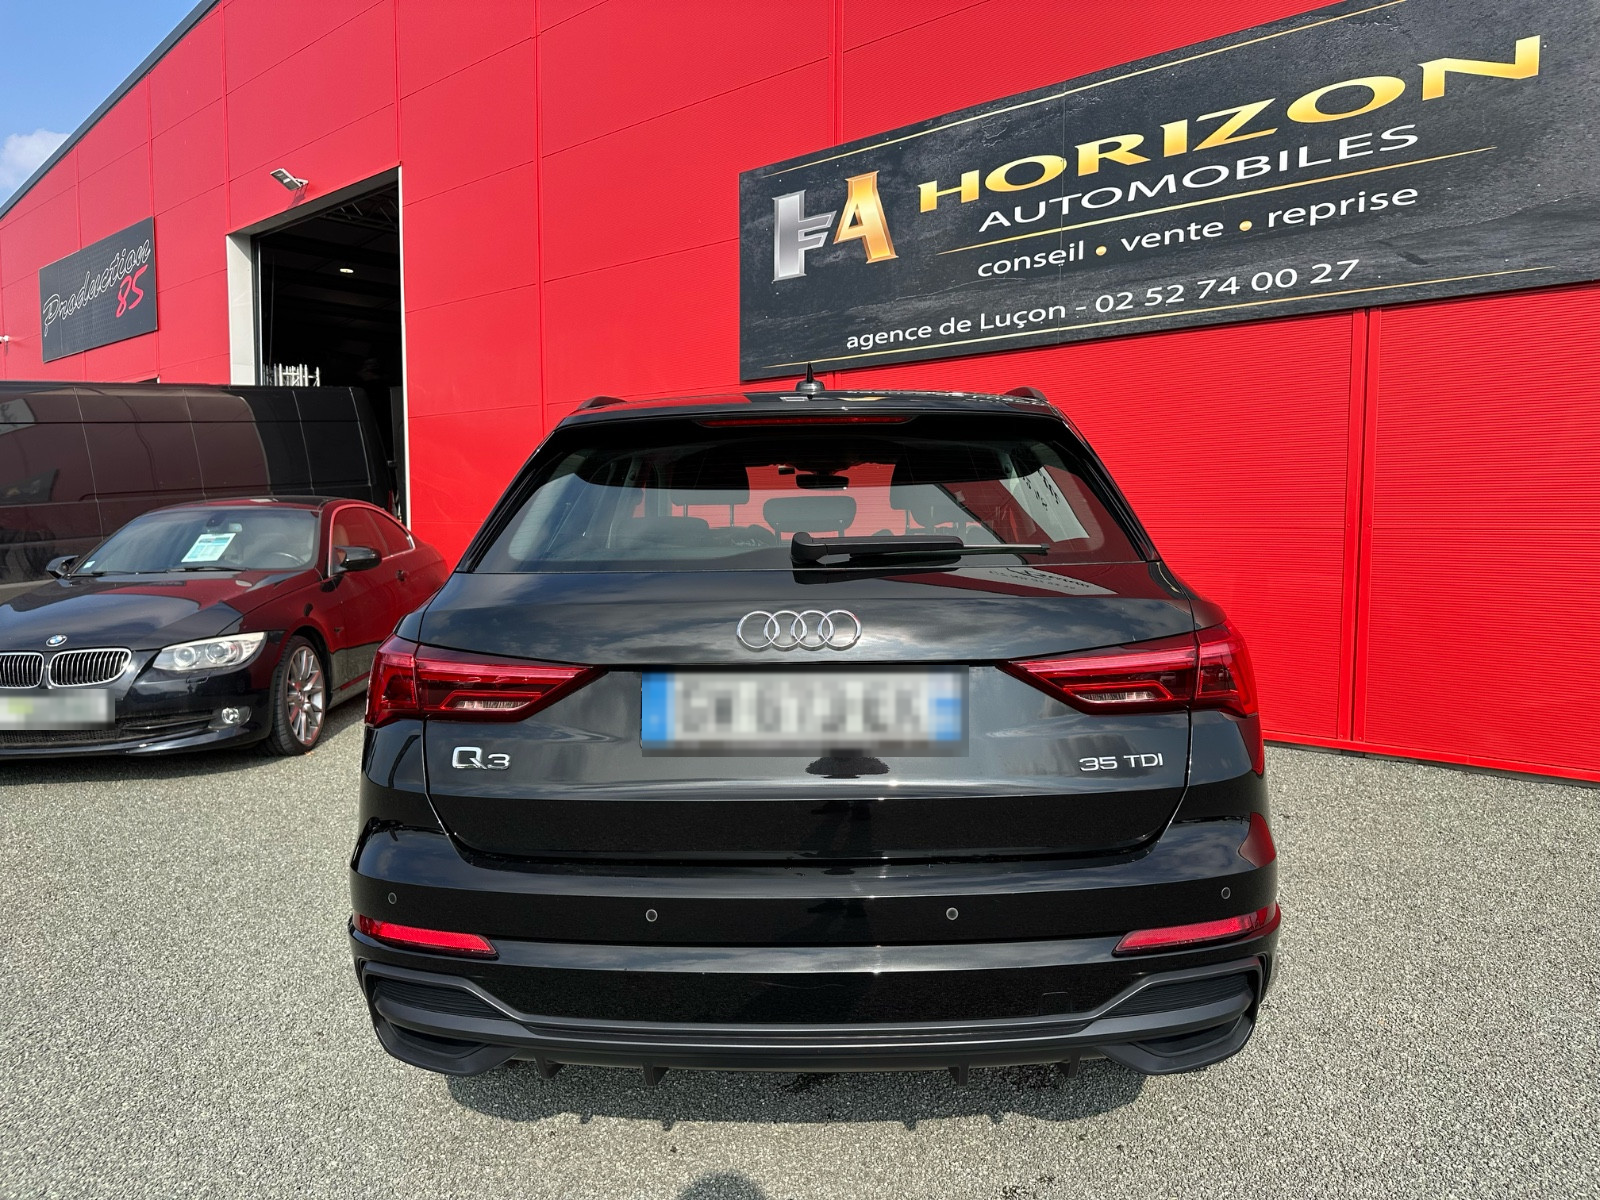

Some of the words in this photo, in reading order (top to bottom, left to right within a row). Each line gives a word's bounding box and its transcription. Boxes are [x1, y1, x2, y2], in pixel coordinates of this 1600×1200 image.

[919, 35, 1541, 213] HORIZON
[979, 124, 1419, 233] AUTOMOBILES
[977, 240, 1084, 278] conseil
[1121, 221, 1224, 252] vente
[1268, 188, 1418, 227] reprise
[43, 239, 151, 337] Production
[116, 264, 148, 318] 85
[846, 325, 932, 350] agence
[939, 317, 972, 335] de
[980, 305, 1066, 328] Luçon
[1095, 292, 1134, 313] 02
[1145, 285, 1185, 306] 52
[1197, 276, 1240, 299] 74
[1251, 268, 1298, 291] 00
[1310, 259, 1359, 284] 27
[452, 746, 510, 769] Q3
[1079, 756, 1118, 771] 35
[1123, 752, 1164, 768] TDI
